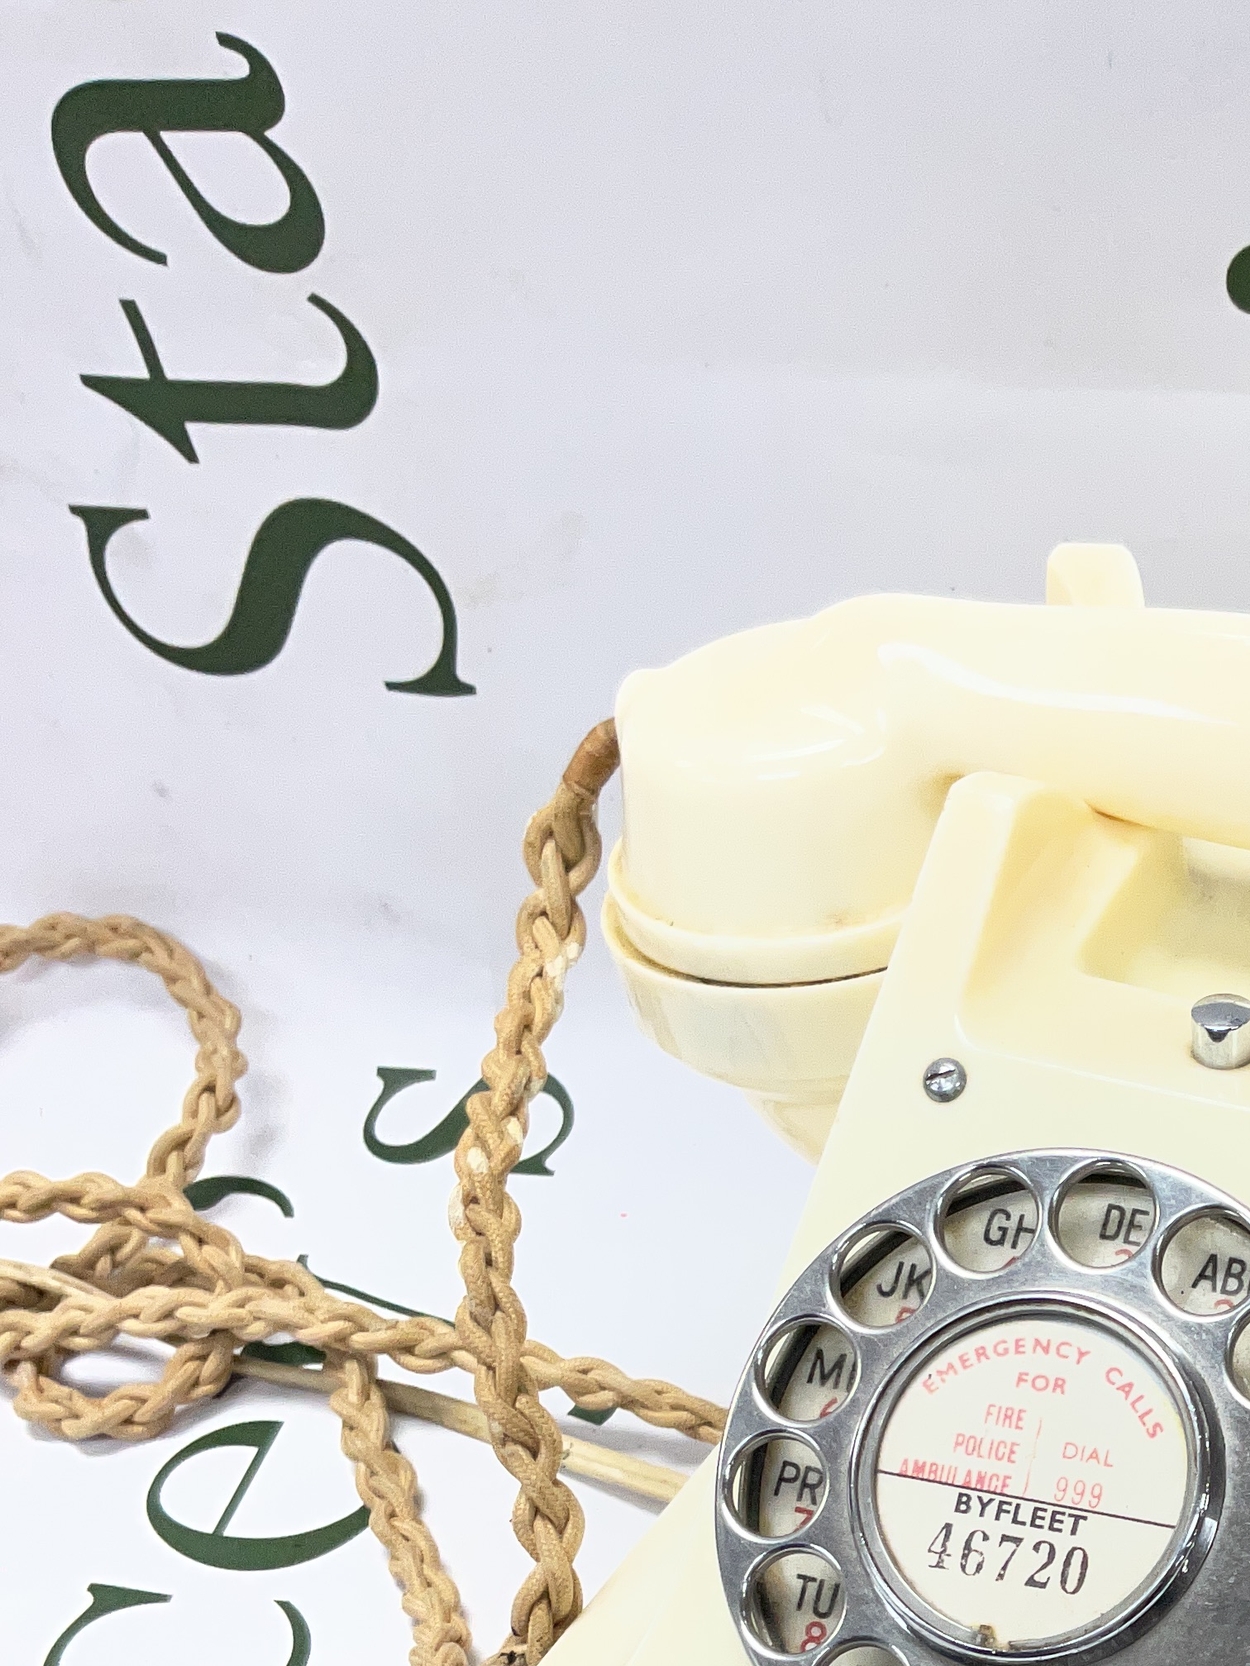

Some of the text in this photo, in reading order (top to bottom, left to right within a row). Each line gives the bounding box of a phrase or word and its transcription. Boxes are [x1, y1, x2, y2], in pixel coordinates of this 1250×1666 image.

[51, 31, 477, 697] Sta
[876, 1261, 933, 1301] JK
[922, 1337, 1165, 1440] EMERGENCY CALLS
[1015, 1371, 1067, 1395] FOR
[984, 1403, 1027, 1431] FIRE
[953, 1432, 1020, 1464] POLICE
[1062, 1442, 1114, 1468] DIAL
[899, 1457, 1012, 1494] AMBULANCE
[1053, 1477, 1104, 1508] 999
[953, 1492, 1089, 1537] BYFLEET
[926, 1522, 1090, 1595] 46720
[796, 1573, 841, 1620] TU
[800, 1620, 827, 1654] 8
